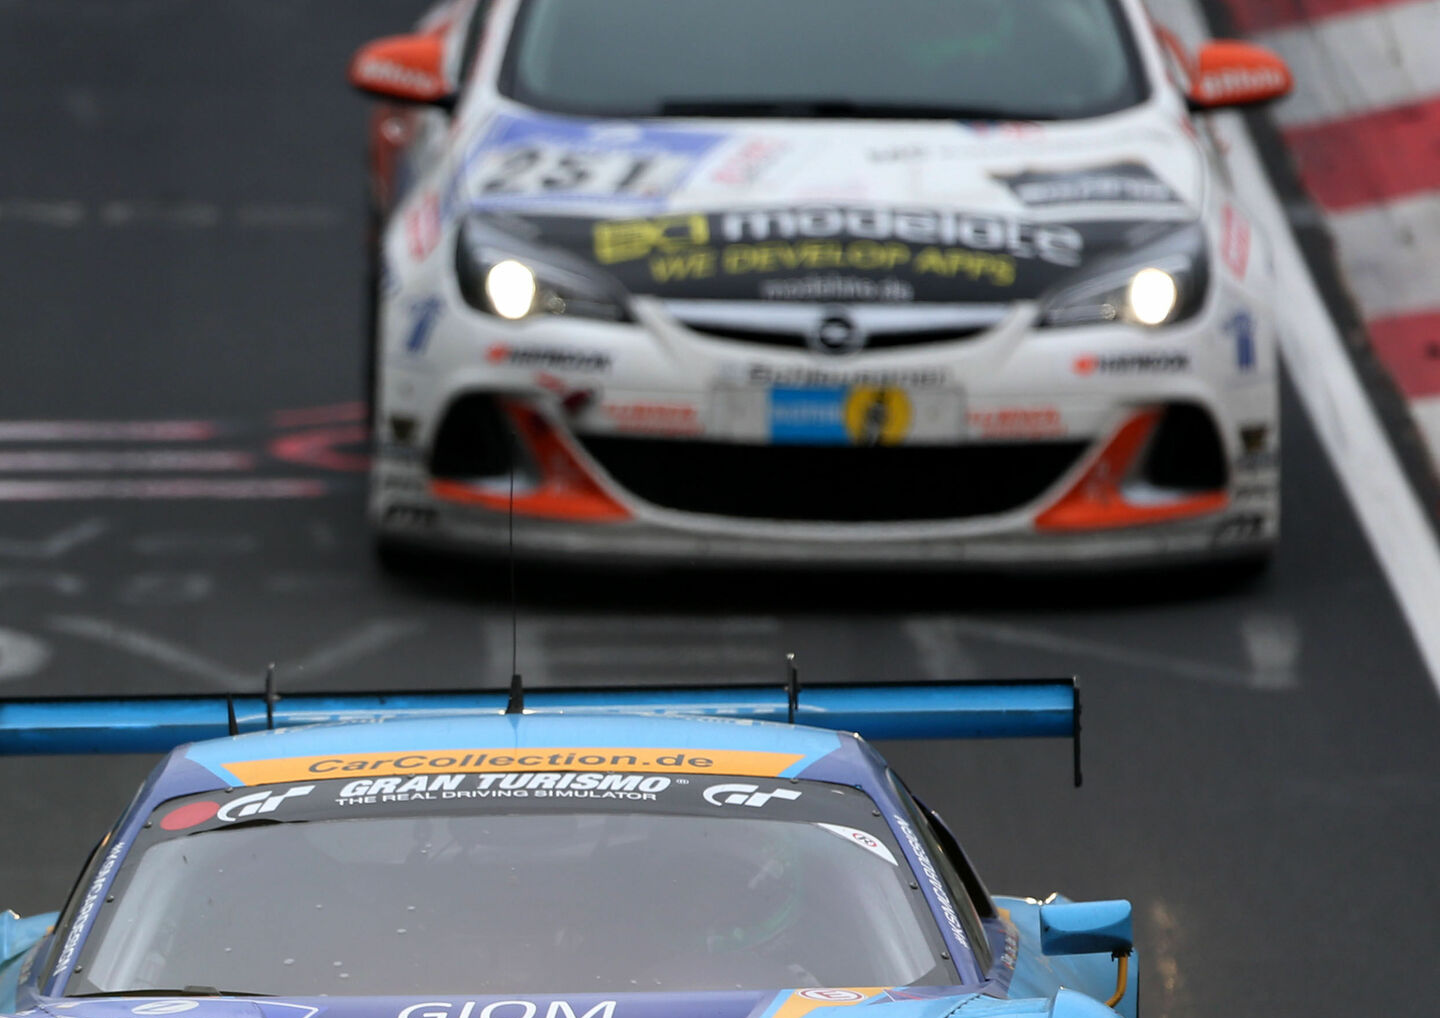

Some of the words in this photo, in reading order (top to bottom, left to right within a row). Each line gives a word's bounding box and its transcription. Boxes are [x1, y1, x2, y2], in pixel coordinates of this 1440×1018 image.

[722, 238, 912, 275] DEVELOP
[913, 245, 1017, 288] APPS
[308, 751, 715, 775] CarCollection.de
[335, 795, 377, 806] THE
[382, 792, 437, 803] REAL
[441, 789, 528, 799] DRIVING
[532, 789, 658, 800] SIMULATOR
[338, 774, 465, 798] GRAN
[475, 772, 672, 793] TURISMO
